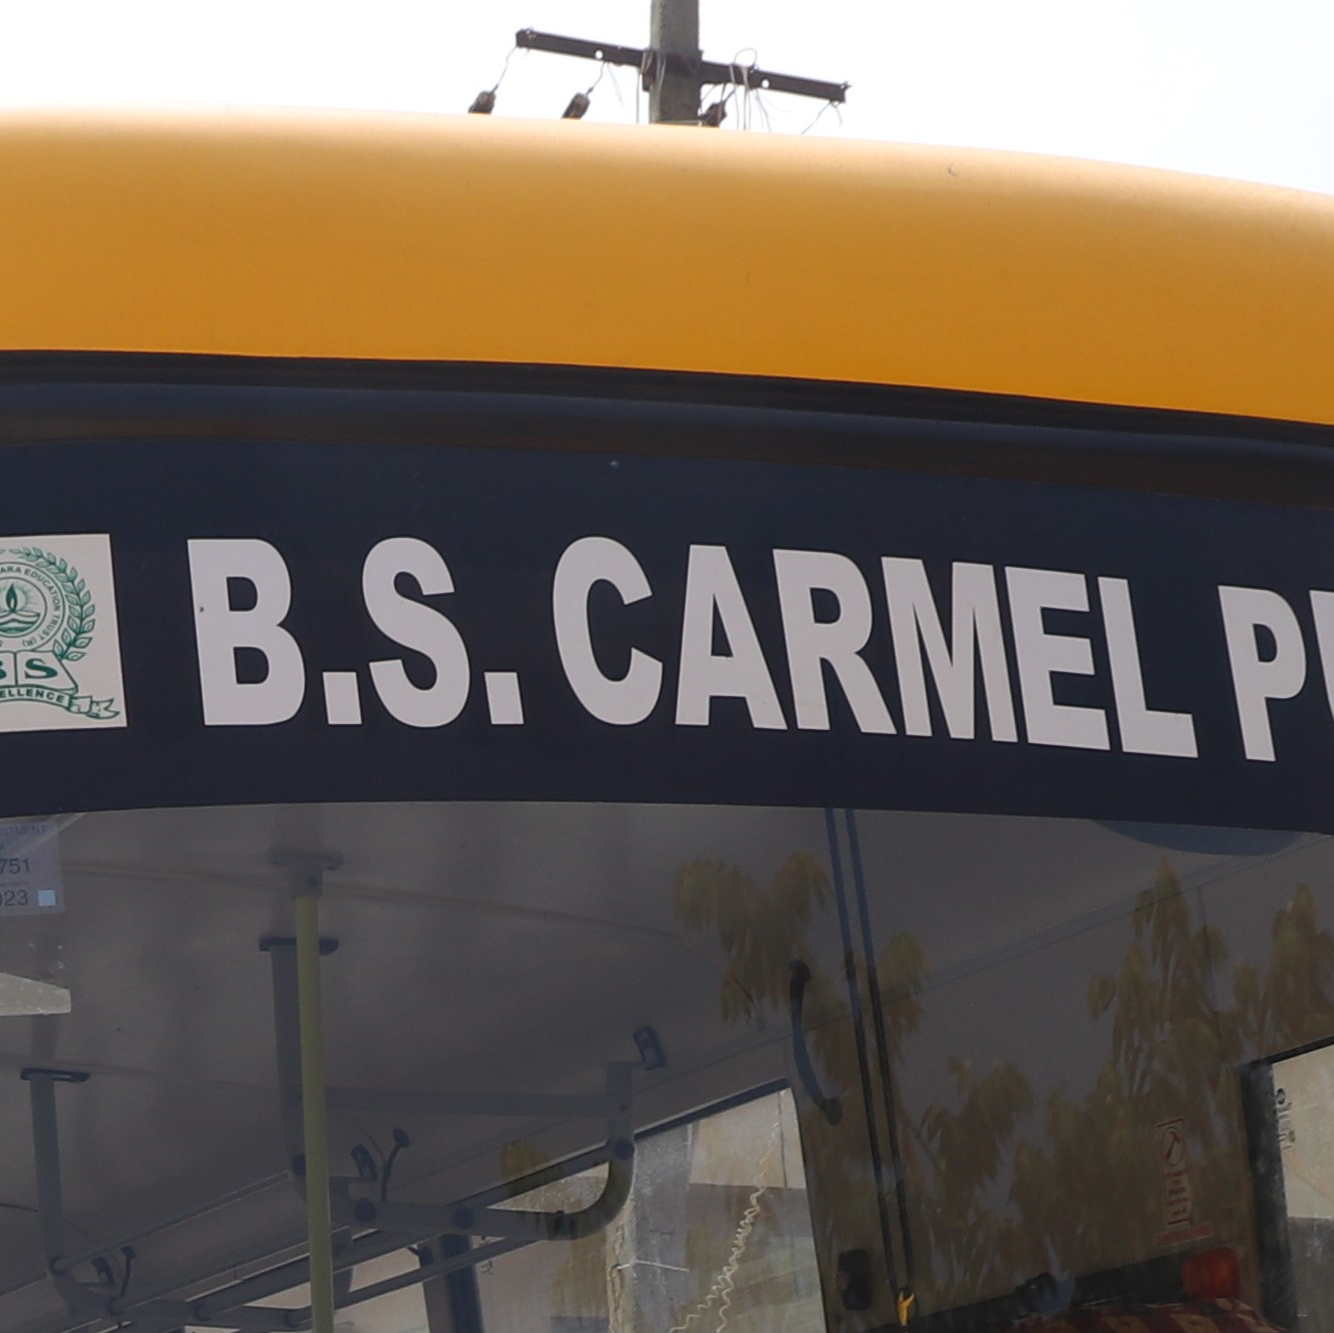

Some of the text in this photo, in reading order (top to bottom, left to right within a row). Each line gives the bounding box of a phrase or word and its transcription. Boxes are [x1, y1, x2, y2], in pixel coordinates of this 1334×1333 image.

[24, 568, 61, 609] EDUCATION
[38, 612, 61, 643] TRUST
[187, 536, 524, 728] B.S.
[552, 536, 1198, 758] CARMEL
